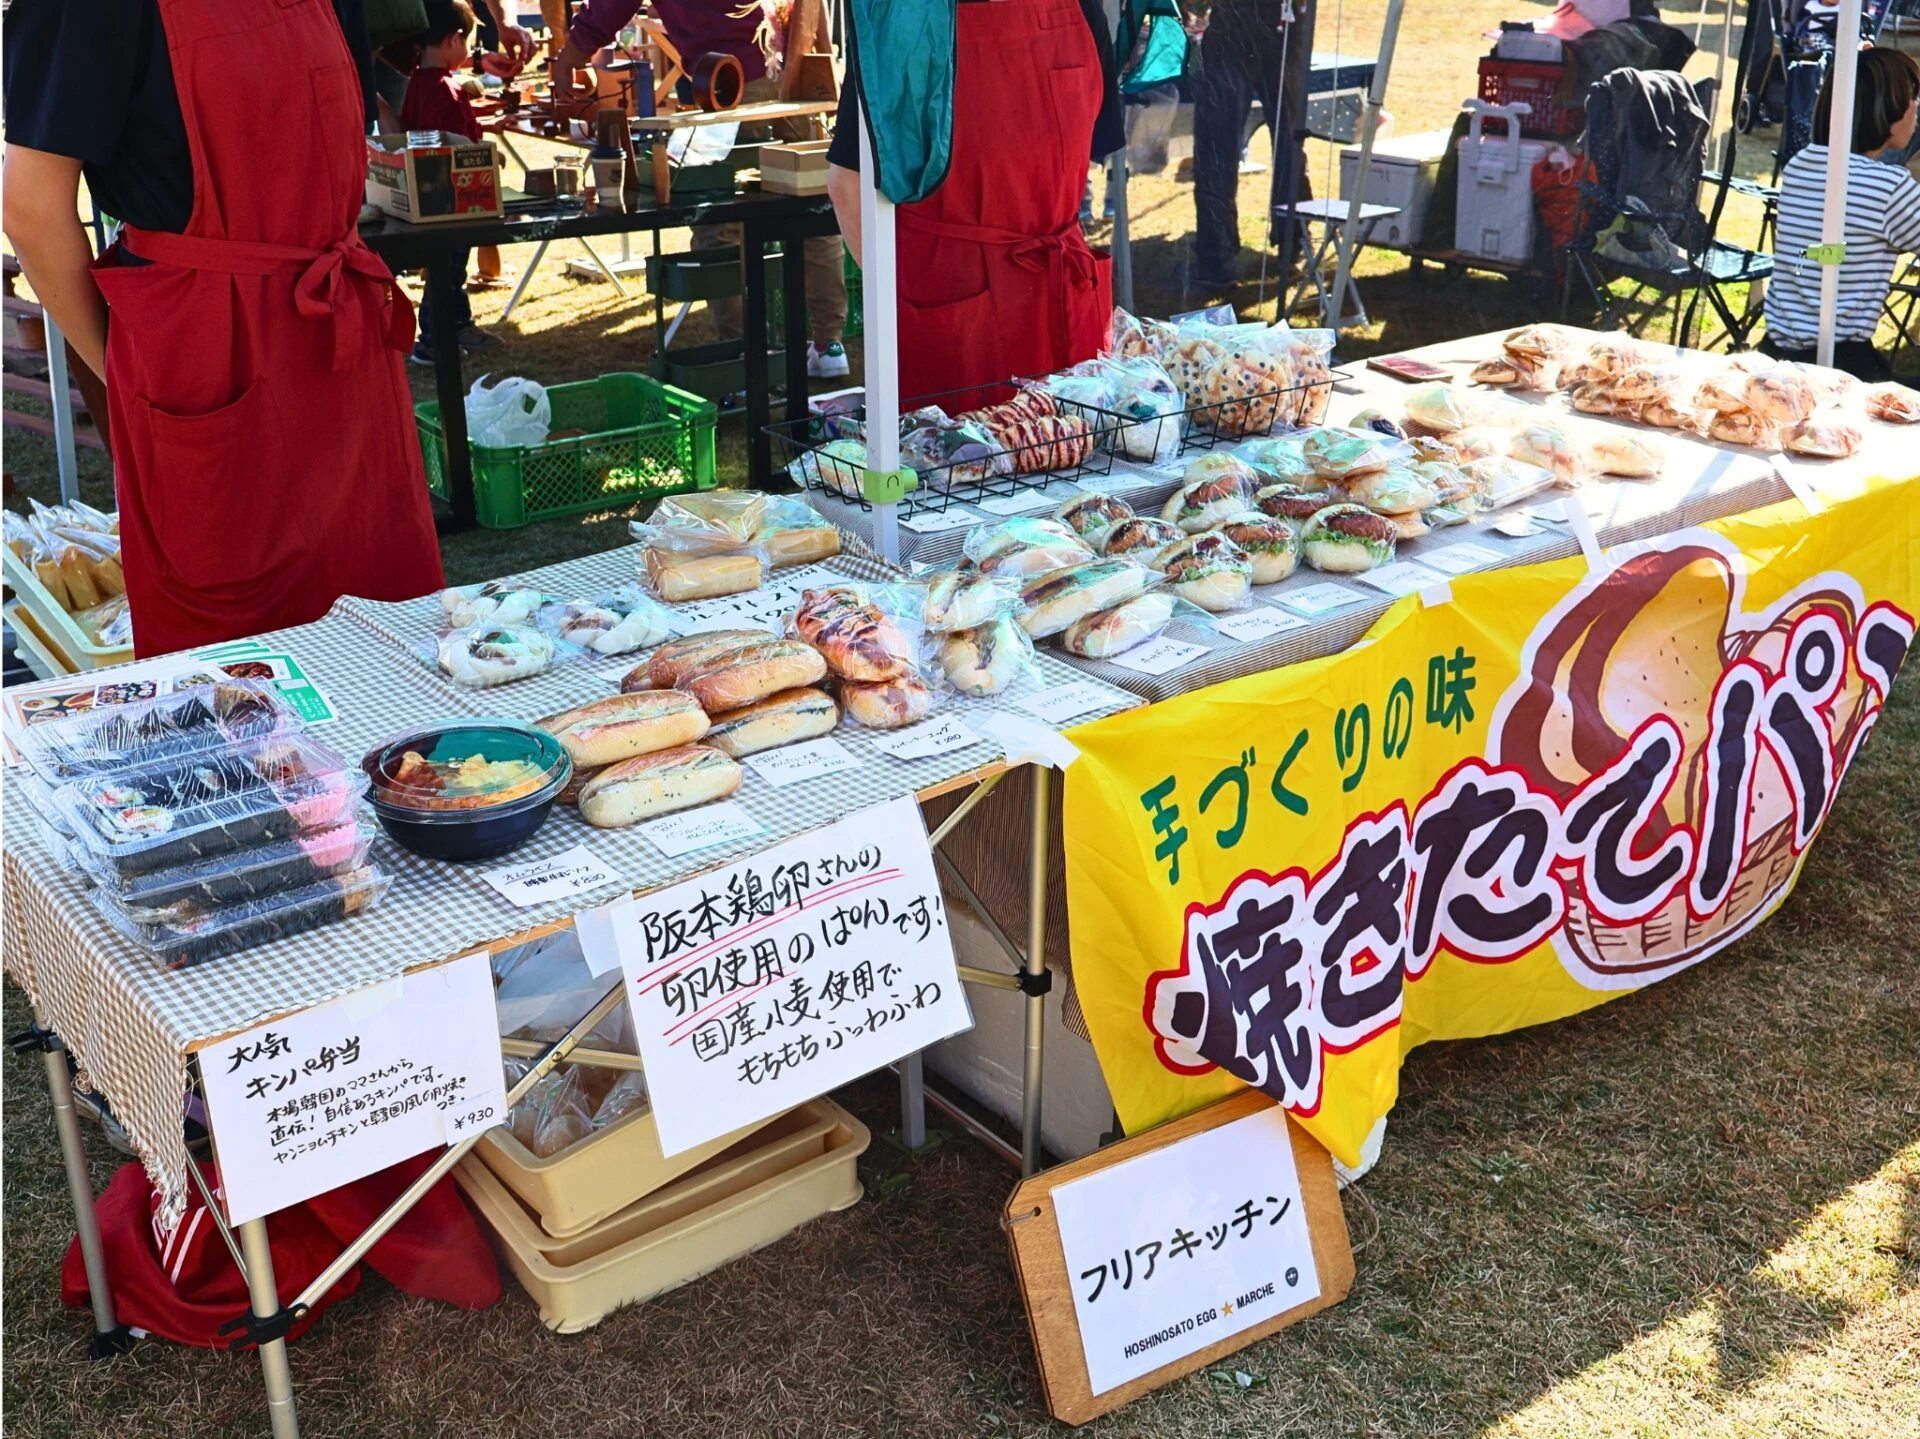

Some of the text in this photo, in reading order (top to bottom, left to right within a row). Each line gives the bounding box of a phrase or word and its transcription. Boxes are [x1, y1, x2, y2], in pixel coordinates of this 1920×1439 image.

[1140, 645, 1477, 886] 手づくりの味
[638, 845, 882, 963] 阪本鶏卵さんの
[226, 1032, 292, 1075] 大人気
[692, 959, 902, 1063] 国産小麦使用で
[245, 1036, 361, 1100] キンパ弁当
[454, 1106, 494, 1130] ¥930
[1080, 1195, 1291, 1303] フリアキッチン
[1124, 1282, 1276, 1359] HOSHINOSATO EGG MARCHE
